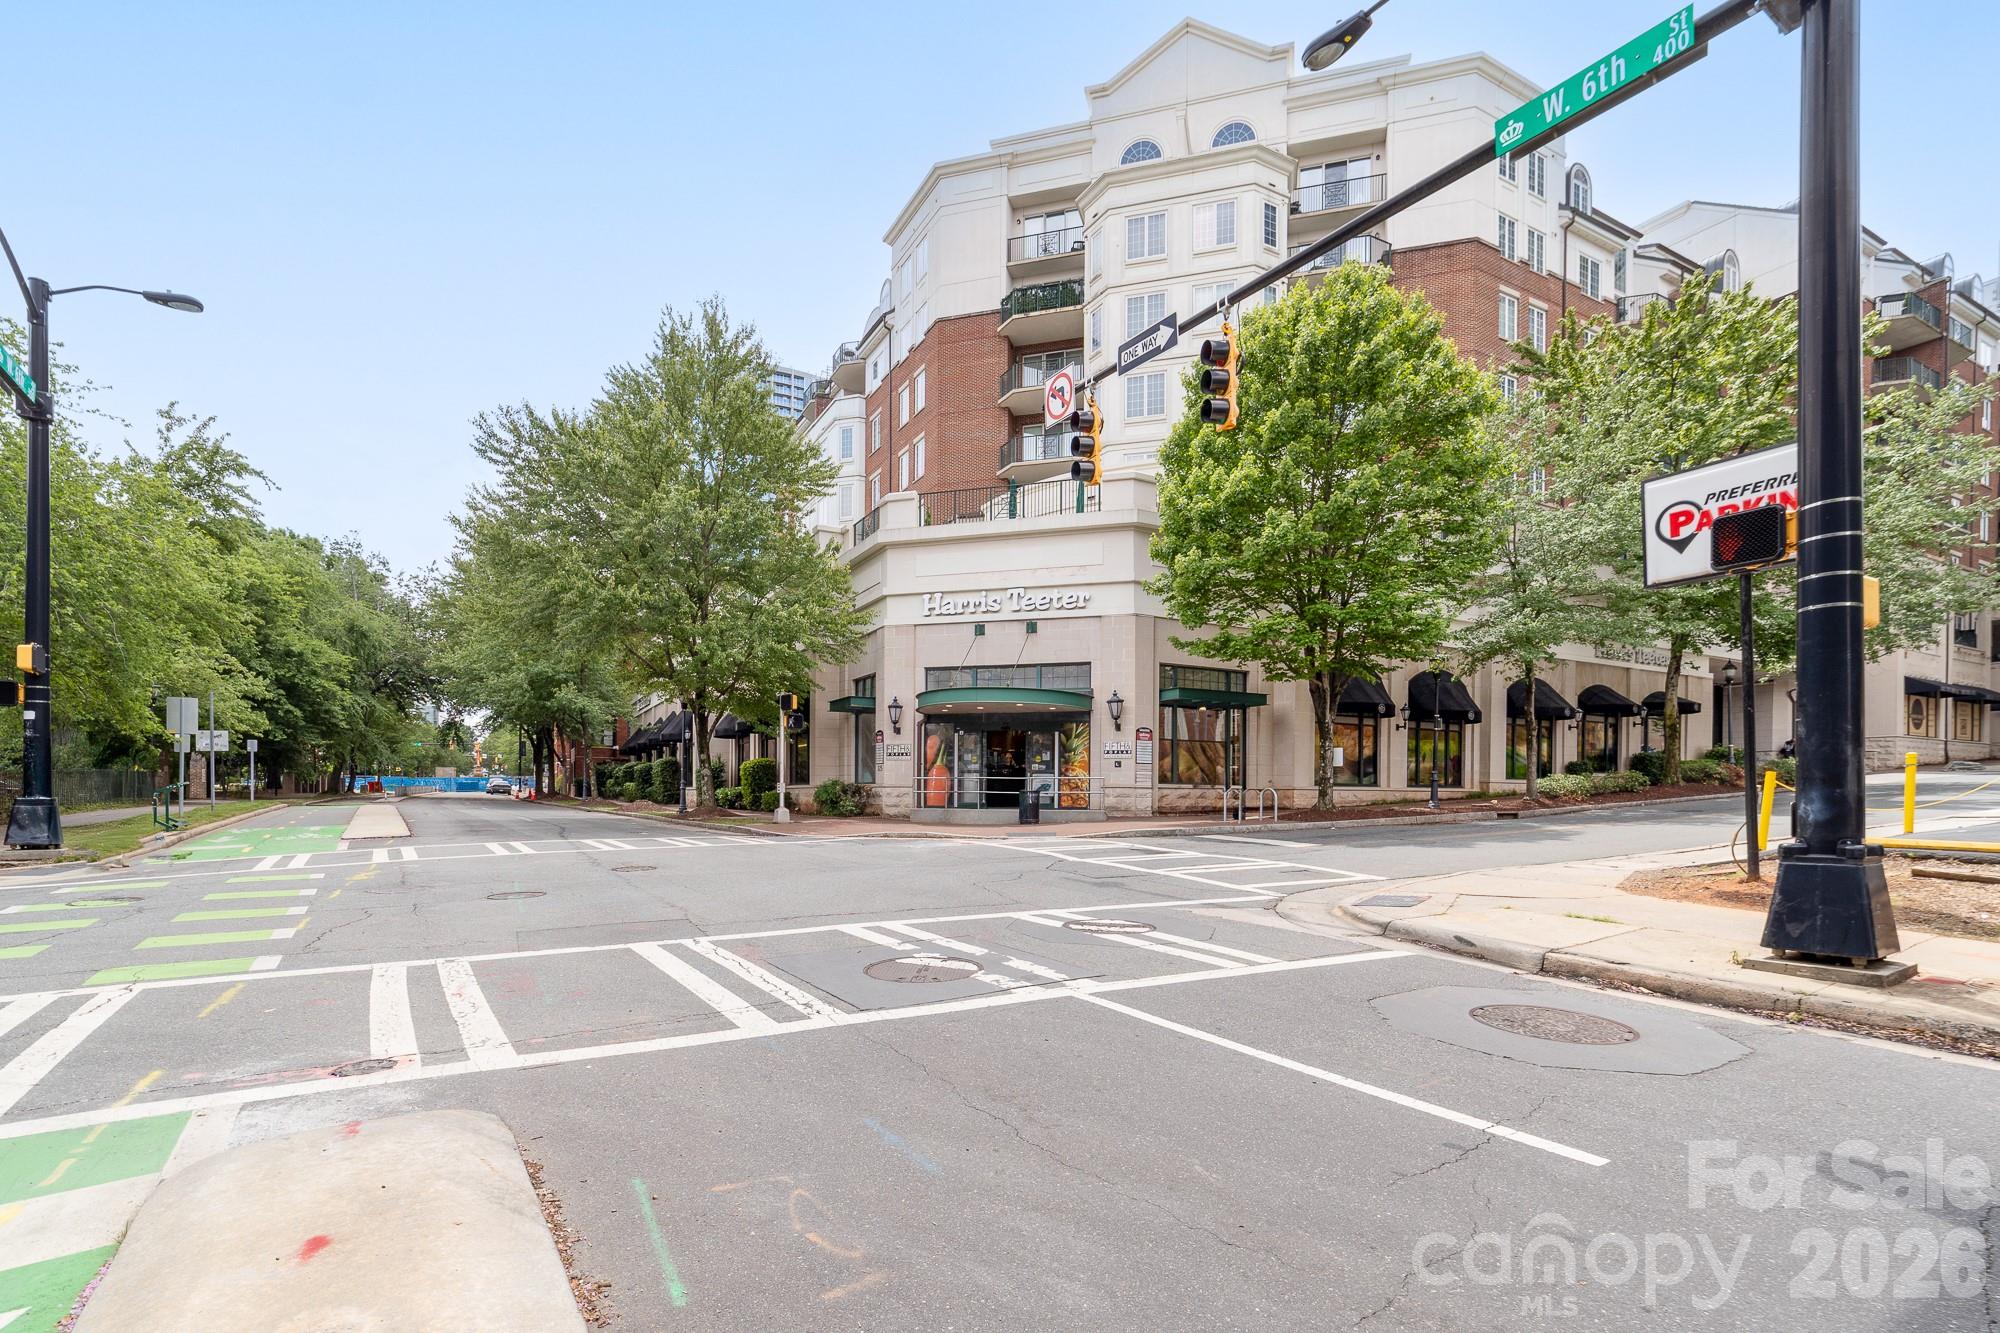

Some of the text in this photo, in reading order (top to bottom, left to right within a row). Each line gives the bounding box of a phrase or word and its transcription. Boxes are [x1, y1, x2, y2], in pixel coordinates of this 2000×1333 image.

[1669, 10, 1688, 37] St
[1653, 29, 1690, 64] 400
[1543, 55, 1626, 123] W. 6th
[1123, 333, 1159, 363] ONE WAY
[922, 587, 1090, 617] Harris Teeter
